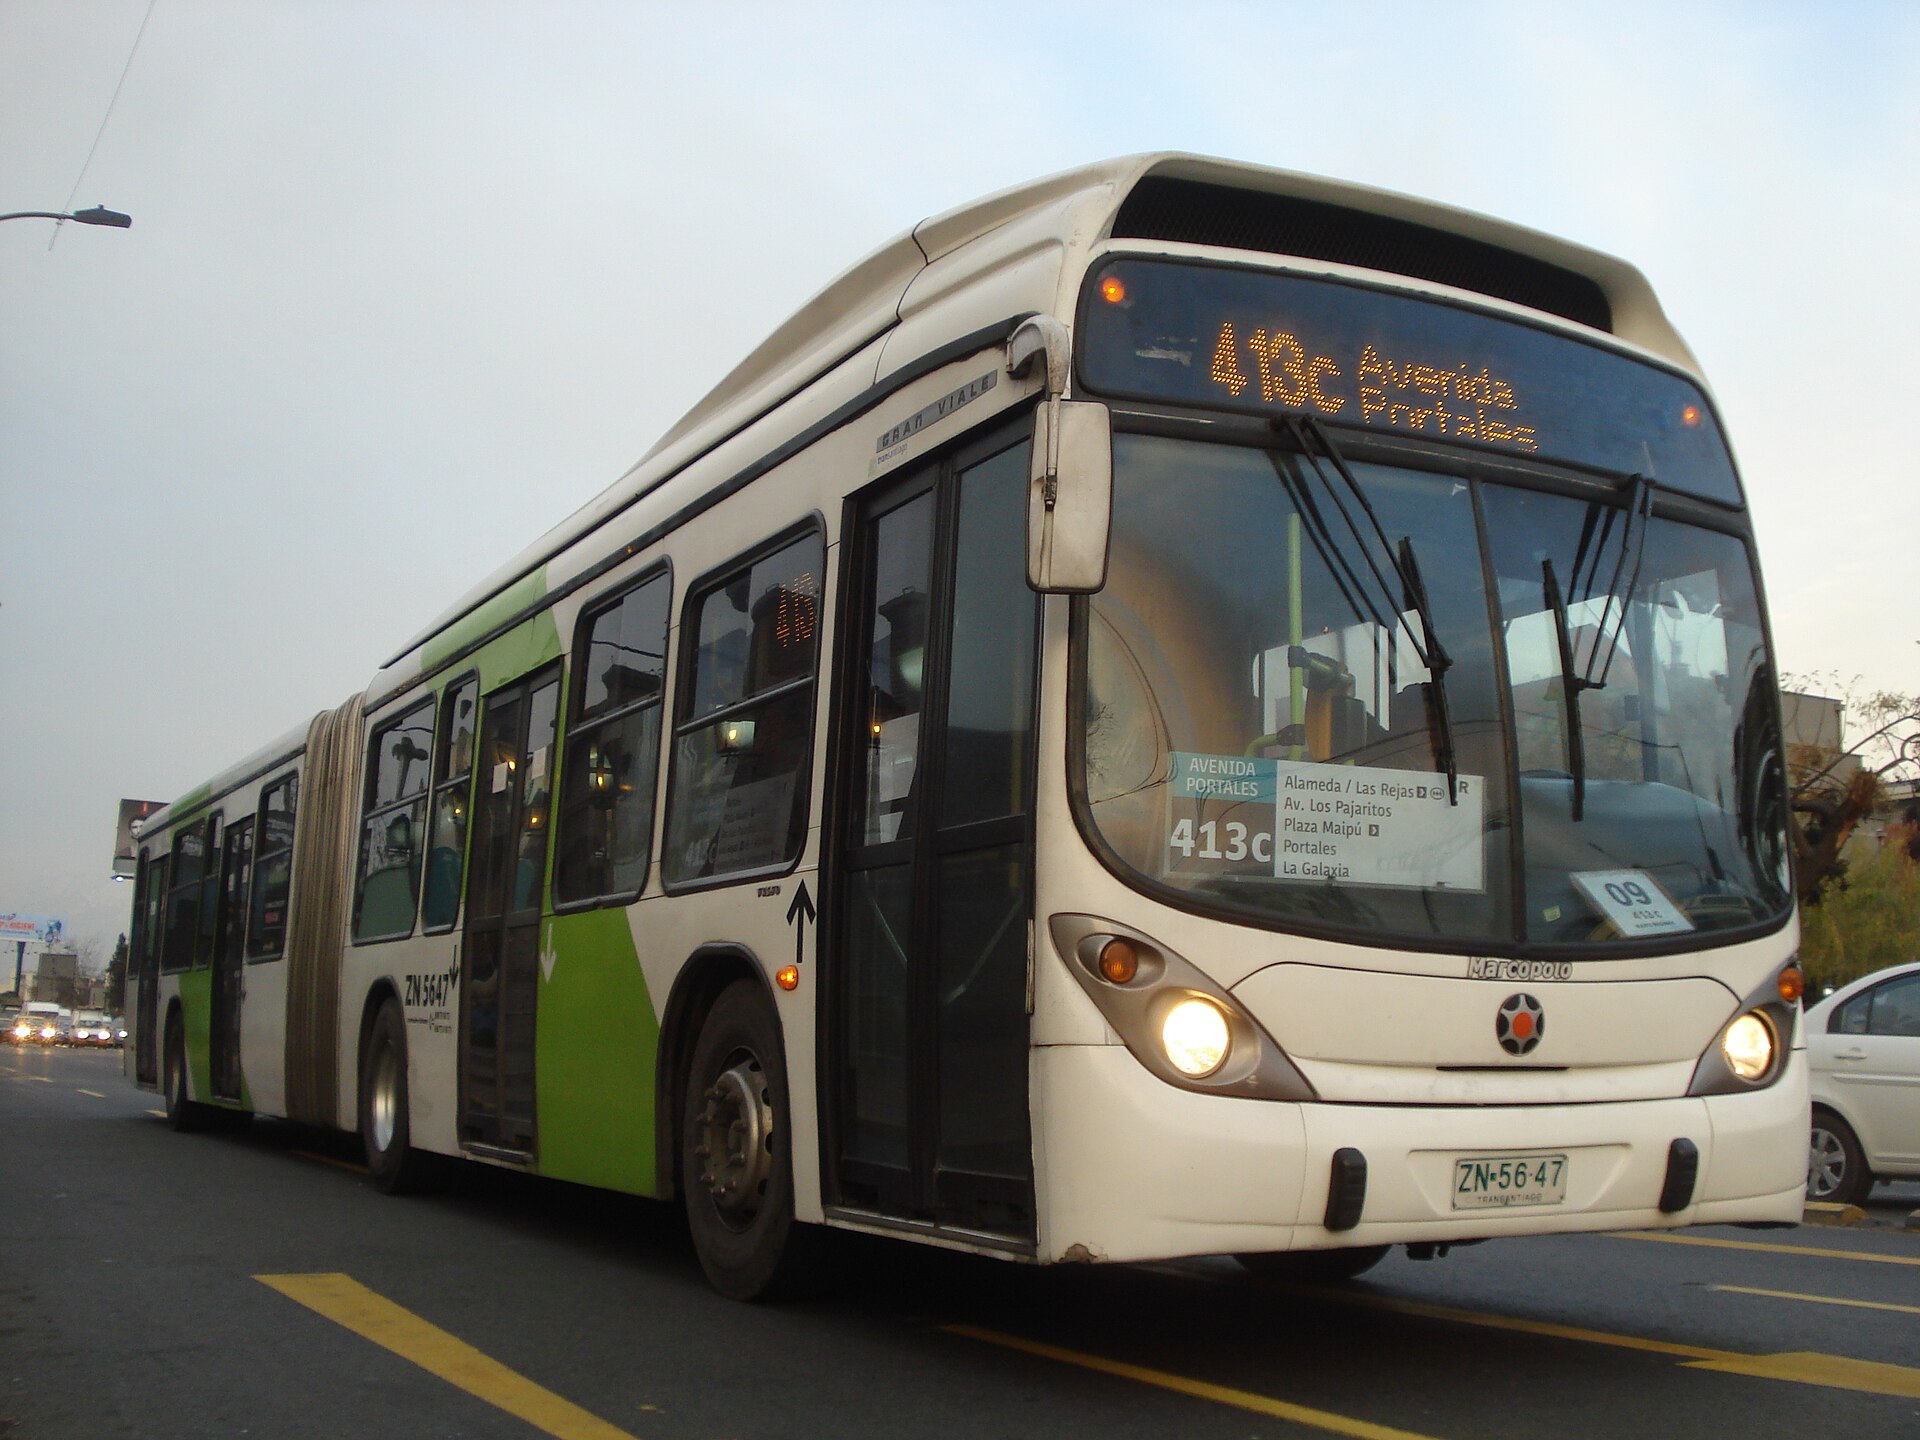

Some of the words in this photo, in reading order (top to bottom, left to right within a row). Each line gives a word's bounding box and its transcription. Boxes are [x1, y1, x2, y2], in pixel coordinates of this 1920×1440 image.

[1358, 344, 1519, 410] Avenida
[938, 376, 989, 415] VIALE
[1190, 757, 1256, 777] AVENIDA
[1186, 777, 1258, 797] PORTALES
[1284, 776, 1341, 793] Alameda
[1356, 781, 1376, 795] Las
[1381, 783, 1414, 801] Rejas
[1284, 799, 1304, 812] Av.
[1310, 800, 1331, 813] Los
[1336, 800, 1392, 818] Pajaritos
[1170, 818, 1271, 862] 413c
[1284, 818, 1318, 834] Plaza
[1323, 821, 1362, 839] Maipú
[1284, 839, 1337, 856] Portales
[1283, 862, 1297, 875] La
[1302, 862, 1350, 878] Galaxia
[1604, 881, 1652, 906] 09
[1467, 956, 1573, 981] Marcopolo
[423, 974, 449, 1008] 5647
